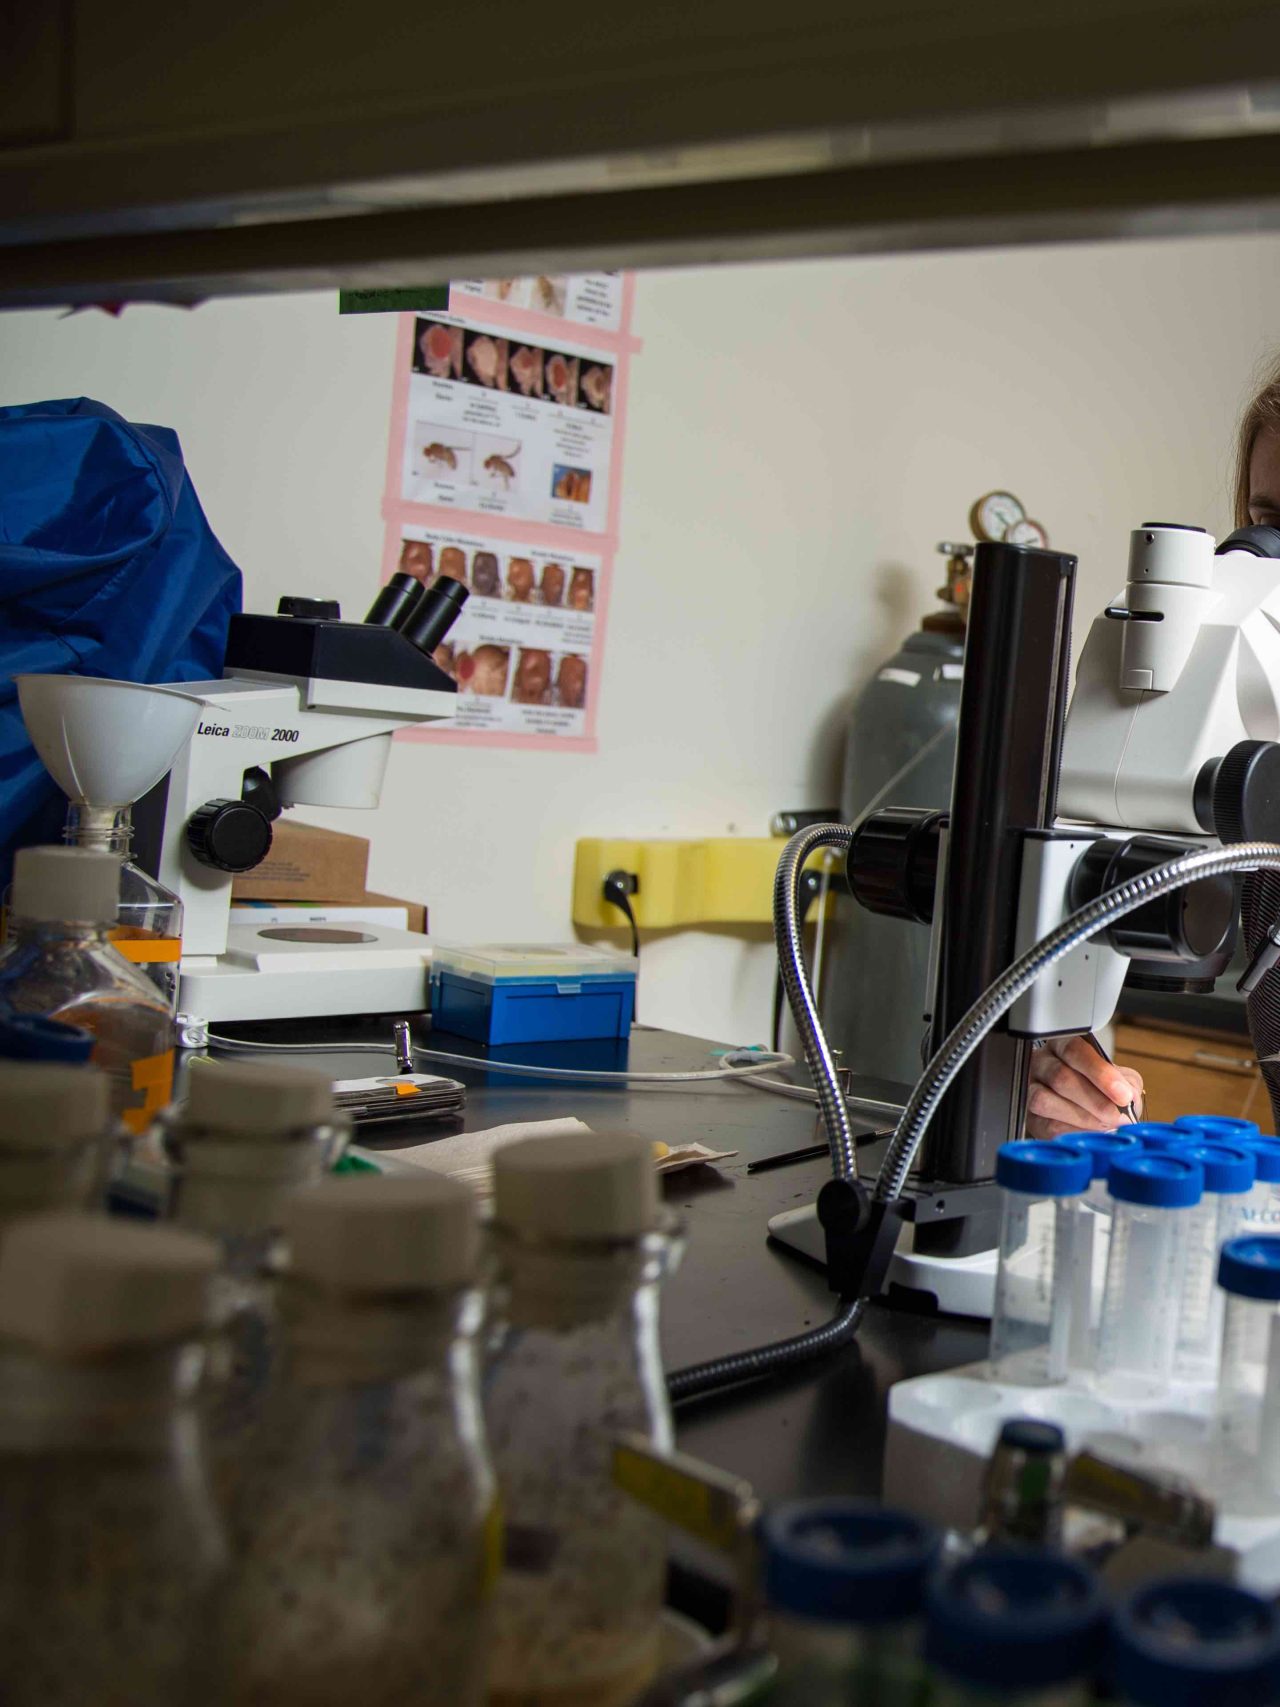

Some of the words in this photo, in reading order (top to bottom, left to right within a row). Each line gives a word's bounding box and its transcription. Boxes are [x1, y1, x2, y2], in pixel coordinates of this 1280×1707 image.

[197, 722, 230, 737] Leica
[232, 724, 270, 740] ZOOM
[271, 728, 299, 742] 2000
